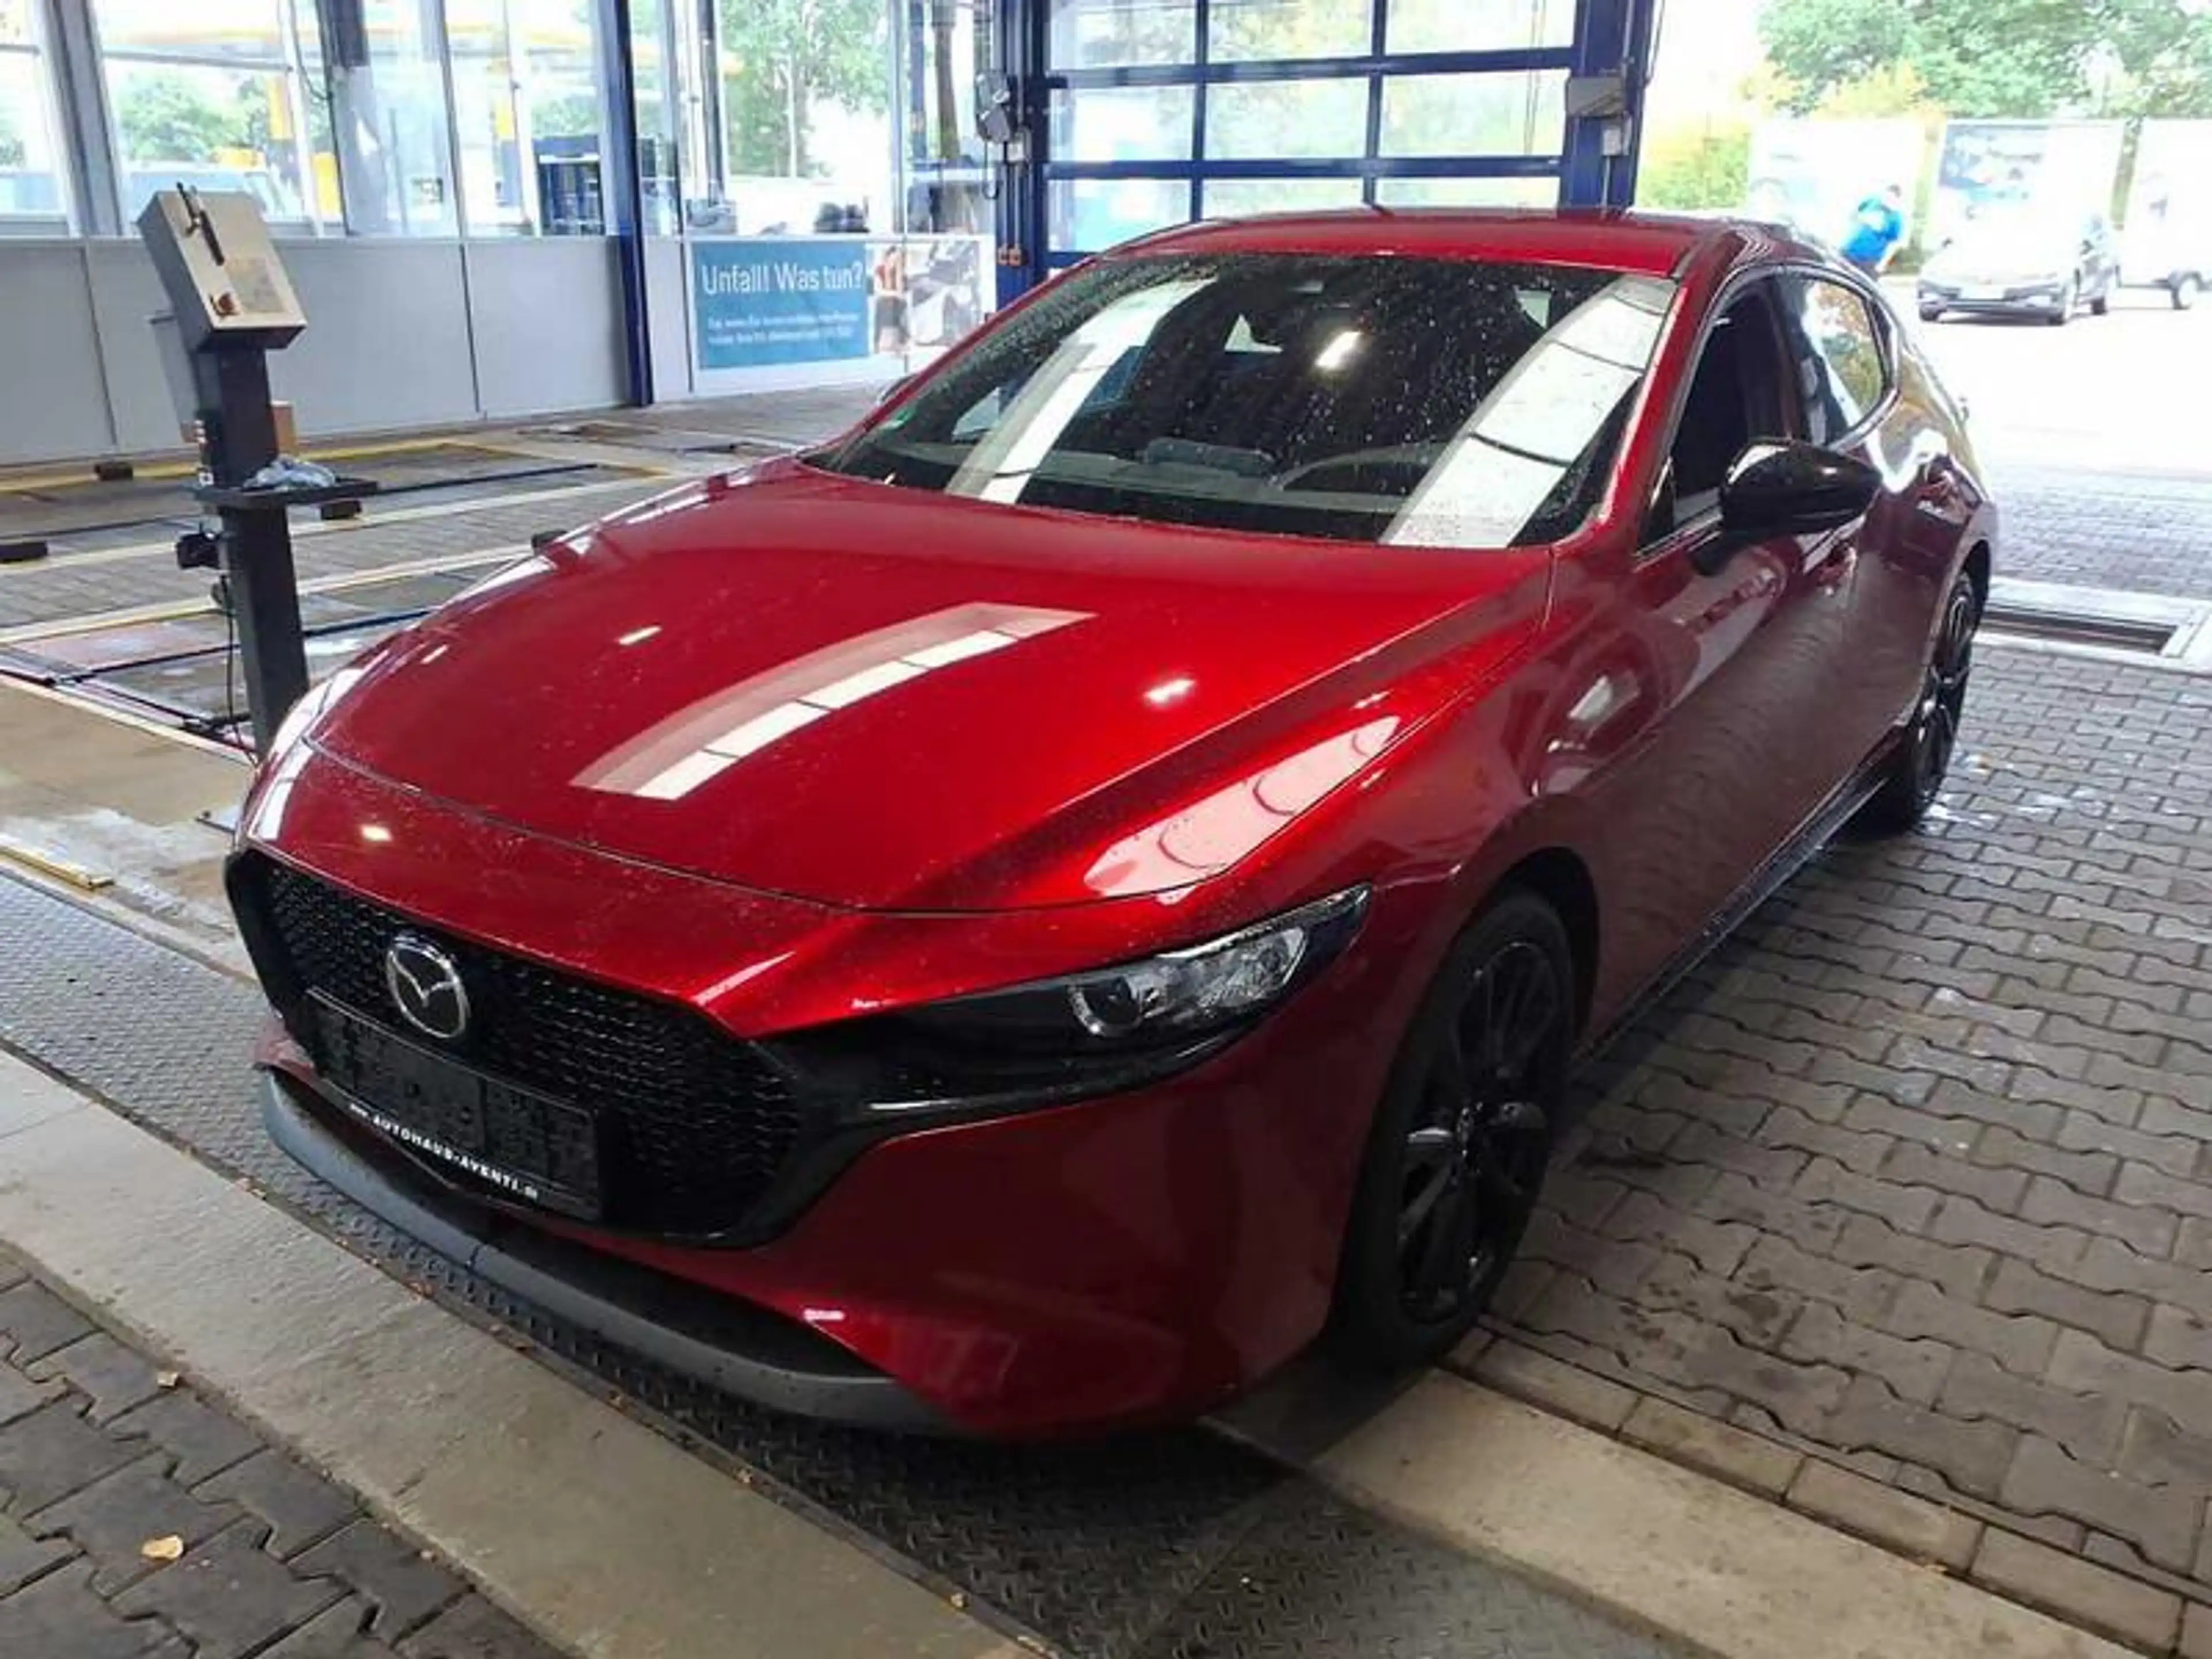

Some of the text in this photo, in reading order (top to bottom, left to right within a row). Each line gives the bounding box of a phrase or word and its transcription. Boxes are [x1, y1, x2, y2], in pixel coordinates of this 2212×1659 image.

[702, 260, 863, 296] Unfall! Was tun?
